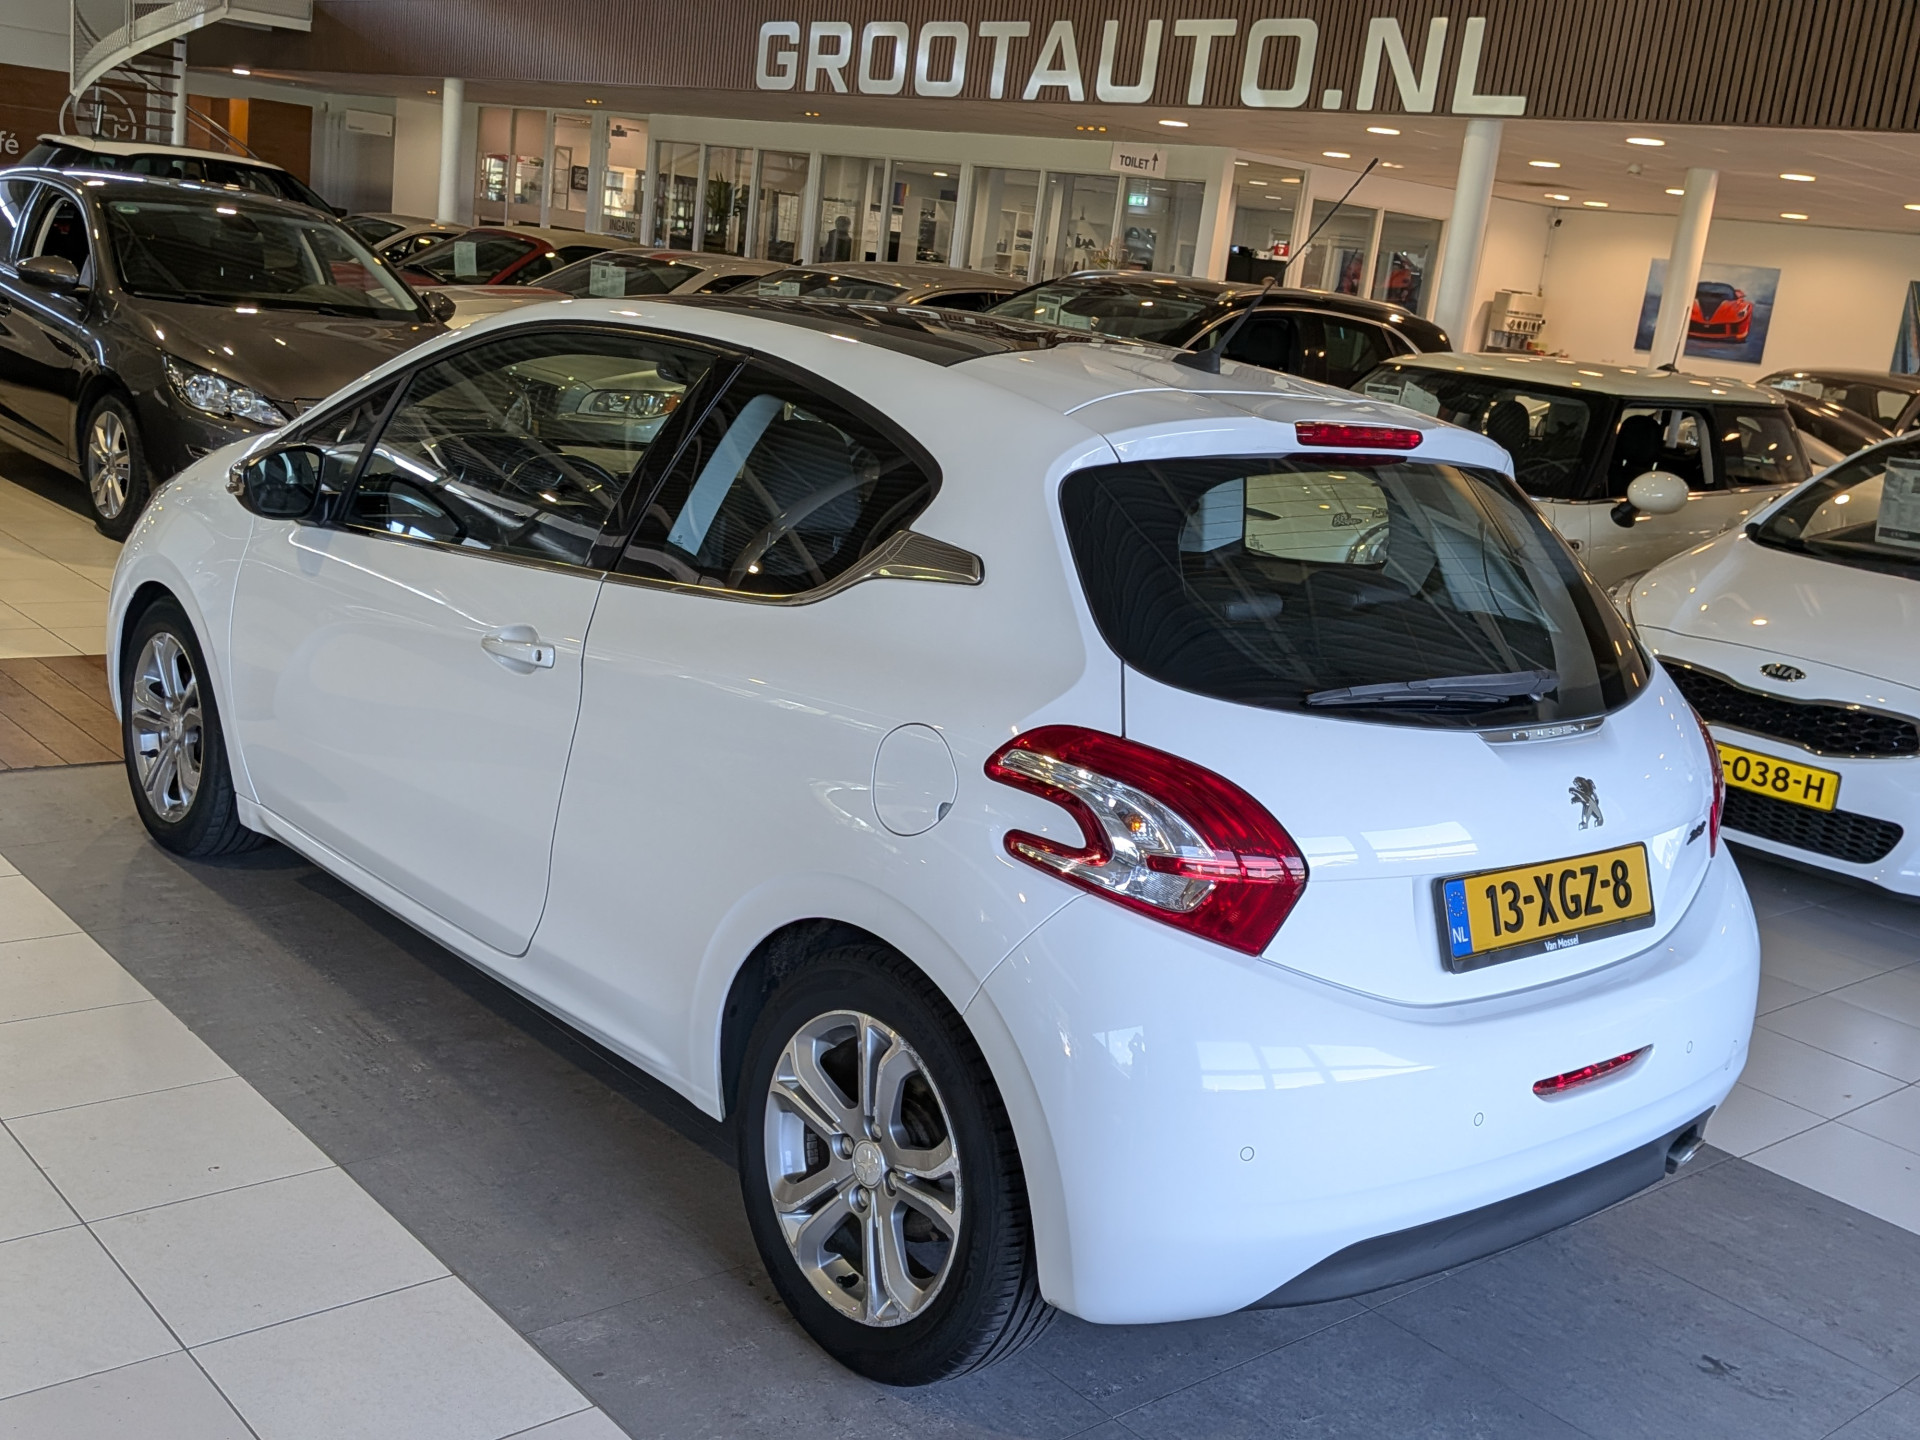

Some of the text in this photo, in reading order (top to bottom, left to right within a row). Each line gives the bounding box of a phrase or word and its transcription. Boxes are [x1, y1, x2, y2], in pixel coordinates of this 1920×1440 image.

[756, 17, 1527, 116] GROOTAUTO.NL
[1119, 154, 1150, 170] TOILET
[609, 218, 636, 234] INGANG
[1765, 664, 1798, 681] KIA
[1716, 748, 1826, 804] -038-H
[1485, 859, 1633, 937] 13-XGZ-8
[1452, 926, 1469, 945] NL
[1544, 934, 1580, 951] Van Mossel
